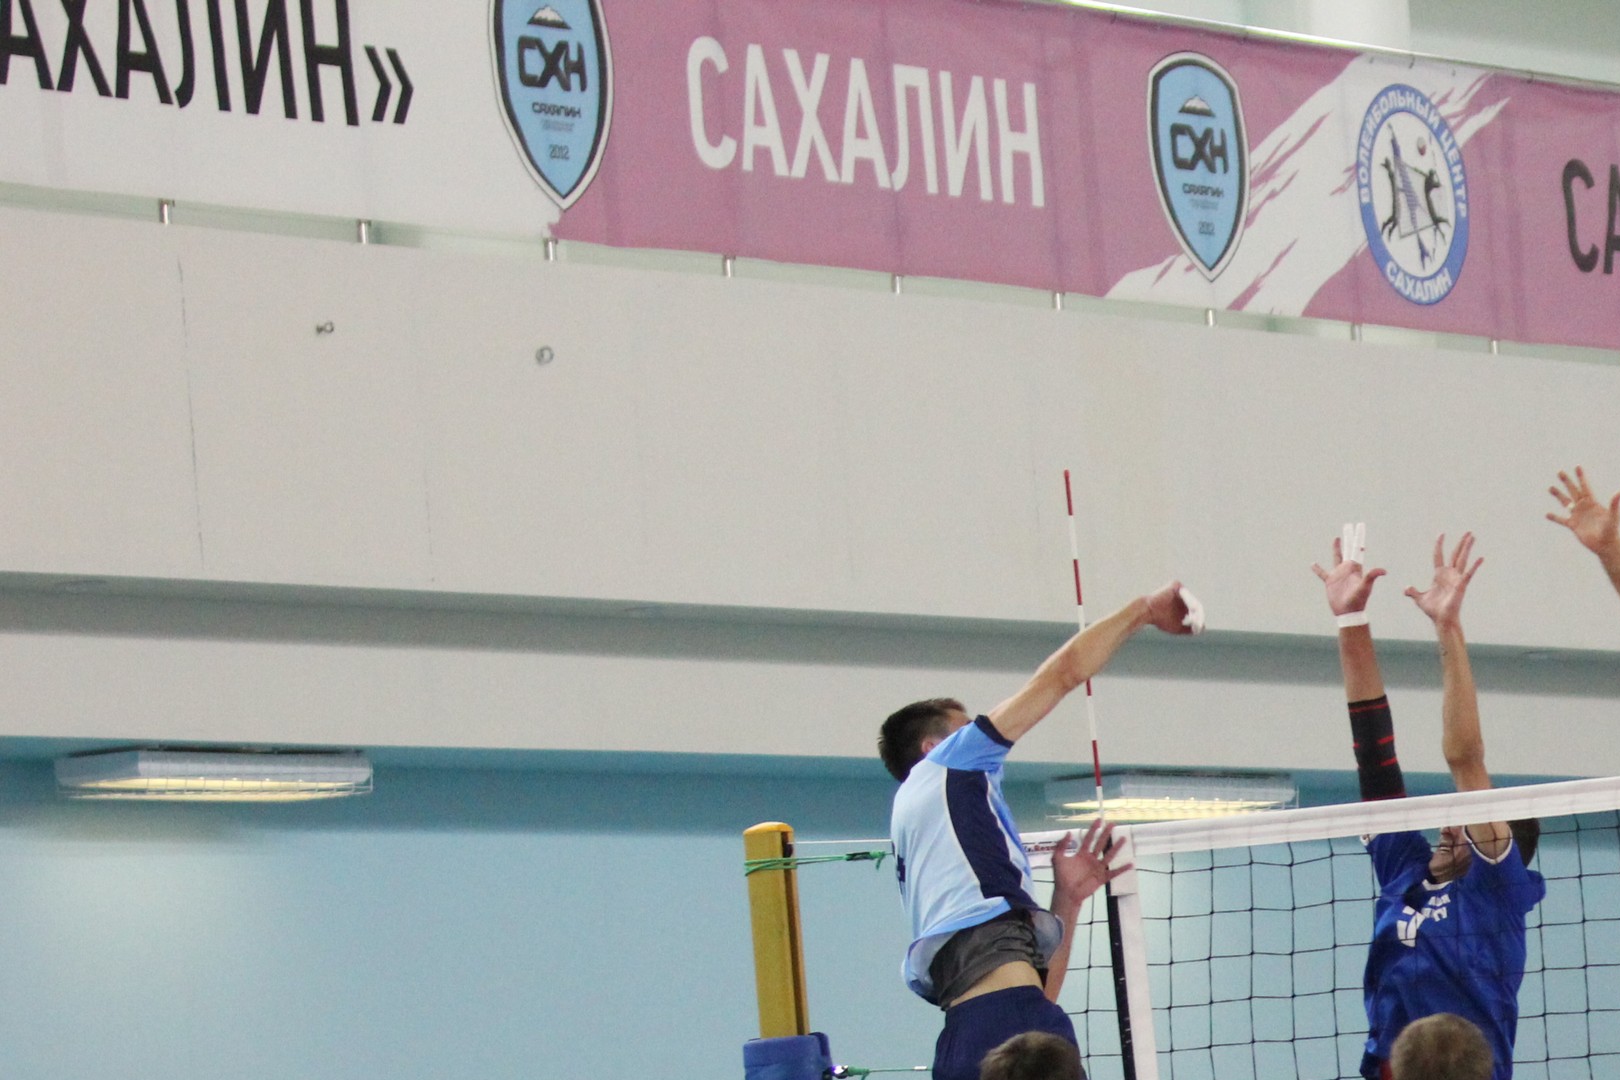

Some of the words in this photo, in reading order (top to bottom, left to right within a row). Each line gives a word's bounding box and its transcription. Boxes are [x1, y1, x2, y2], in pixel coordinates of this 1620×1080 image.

[687, 36, 1046, 207] САХАЛИН
[1358, 88, 1441, 204] ВОЛЕЙБОЛЬНЫЙ
[1440, 128, 1468, 219] ЦЕНТР
[1386, 260, 1453, 302] САХАЛИН
